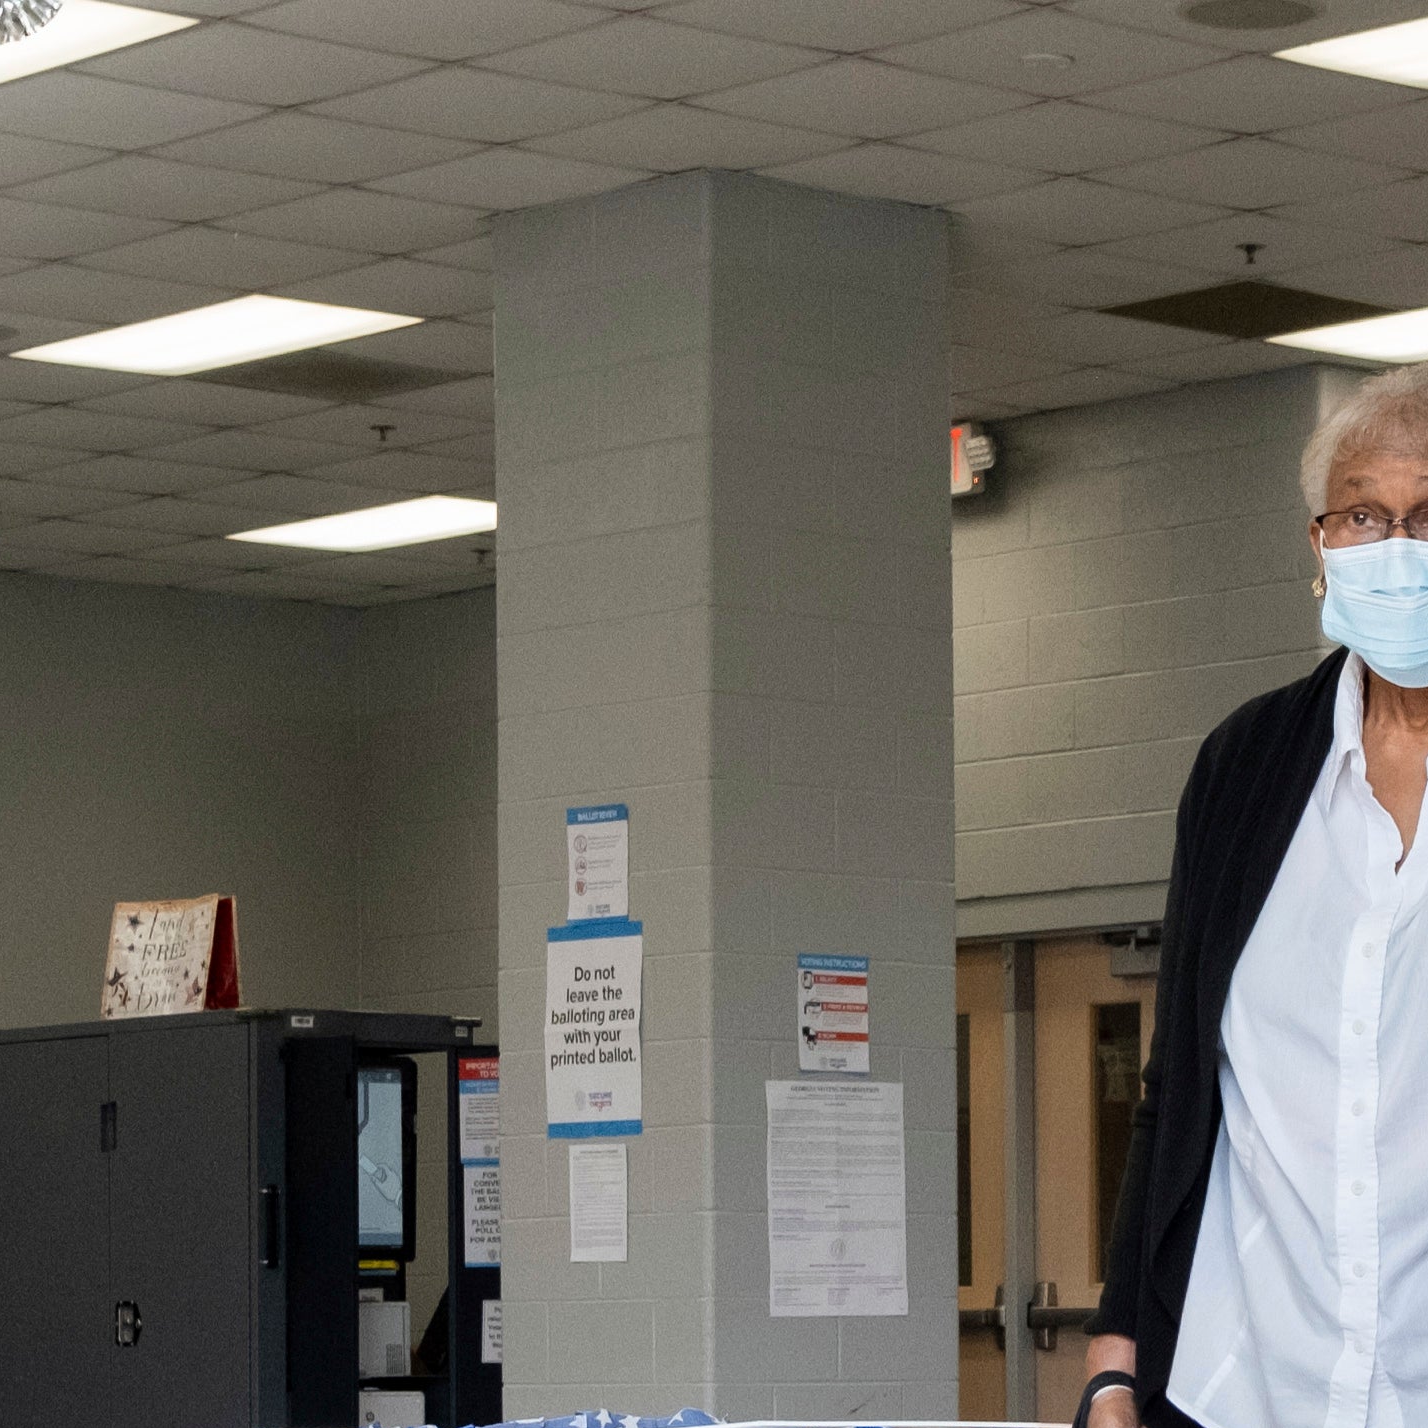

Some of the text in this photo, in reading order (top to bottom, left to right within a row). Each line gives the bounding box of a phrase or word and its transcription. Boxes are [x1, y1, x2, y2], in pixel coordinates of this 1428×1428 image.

[141, 941, 188, 961] FREE
[824, 958, 867, 969] INSTRUCTIONS
[574, 965, 615, 982] Do not
[566, 985, 623, 1003] leave the
[551, 1007, 635, 1026] balloting area
[564, 1028, 621, 1046] with your
[550, 1047, 637, 1070] printed ballot.
